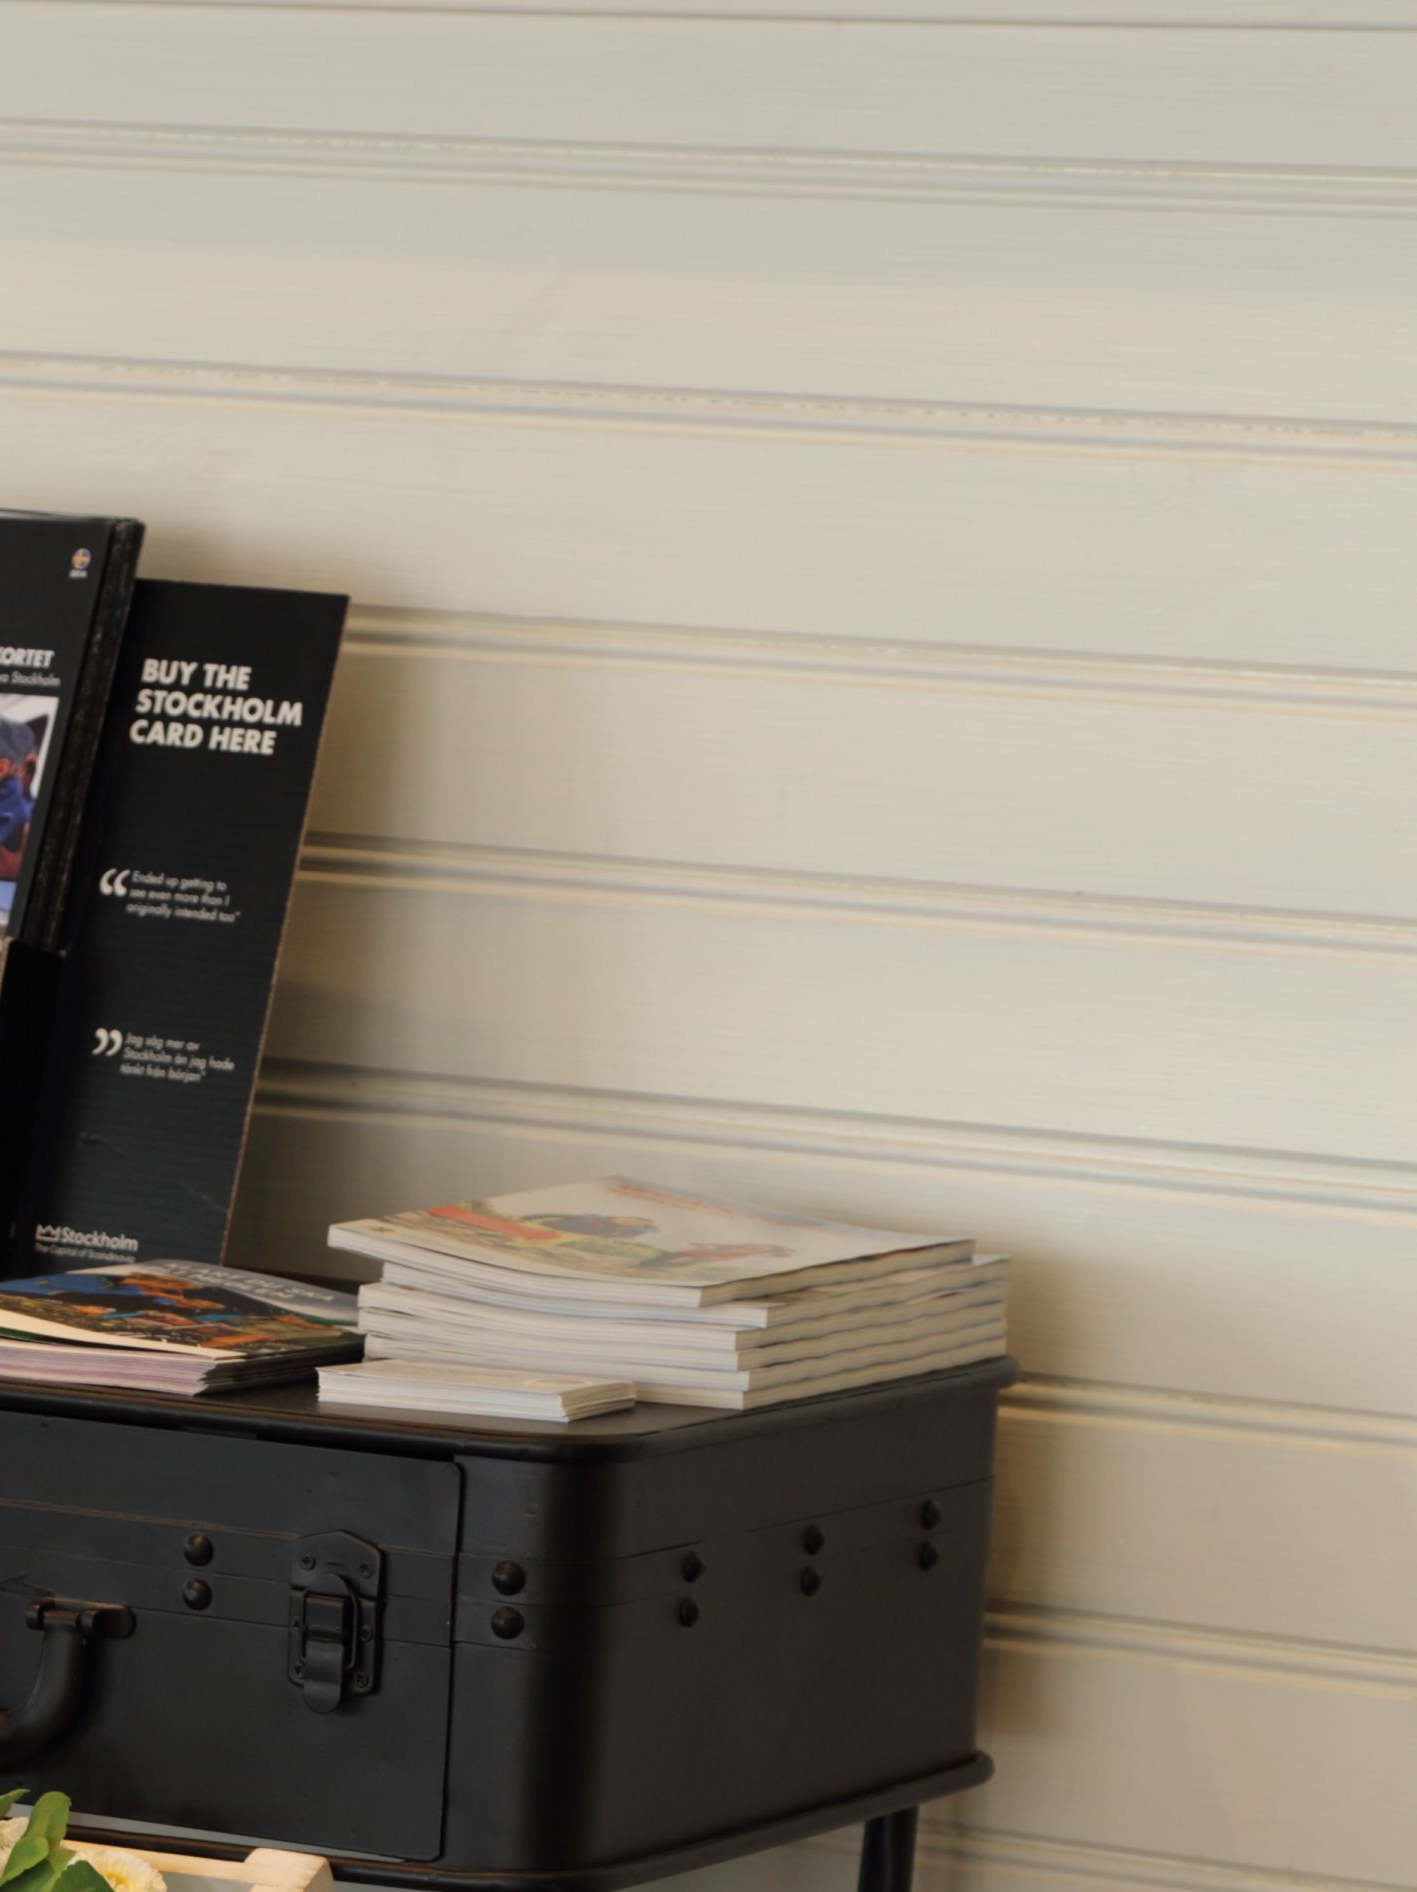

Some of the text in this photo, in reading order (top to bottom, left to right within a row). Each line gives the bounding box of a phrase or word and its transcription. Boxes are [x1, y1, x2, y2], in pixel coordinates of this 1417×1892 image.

[10, 670, 61, 687] Stockholm
[141, 657, 252, 691] BUY THE
[135, 688, 304, 727] STOCKHOLM
[129, 718, 277, 756] CARD HERE
[165, 877, 179, 889] up
[180, 877, 215, 893] getting
[216, 879, 227, 892] to
[129, 888, 147, 897] see
[148, 890, 172, 899] even
[174, 892, 199, 903] more
[200, 892, 223, 905] than
[126, 902, 172, 919] originally
[174, 905, 218, 920] intended
[186, 1041, 200, 1051] av
[123, 1046, 173, 1062] Stockholm
[209, 1055, 235, 1070] hade
[60, 1226, 139, 1252] Stockholm
